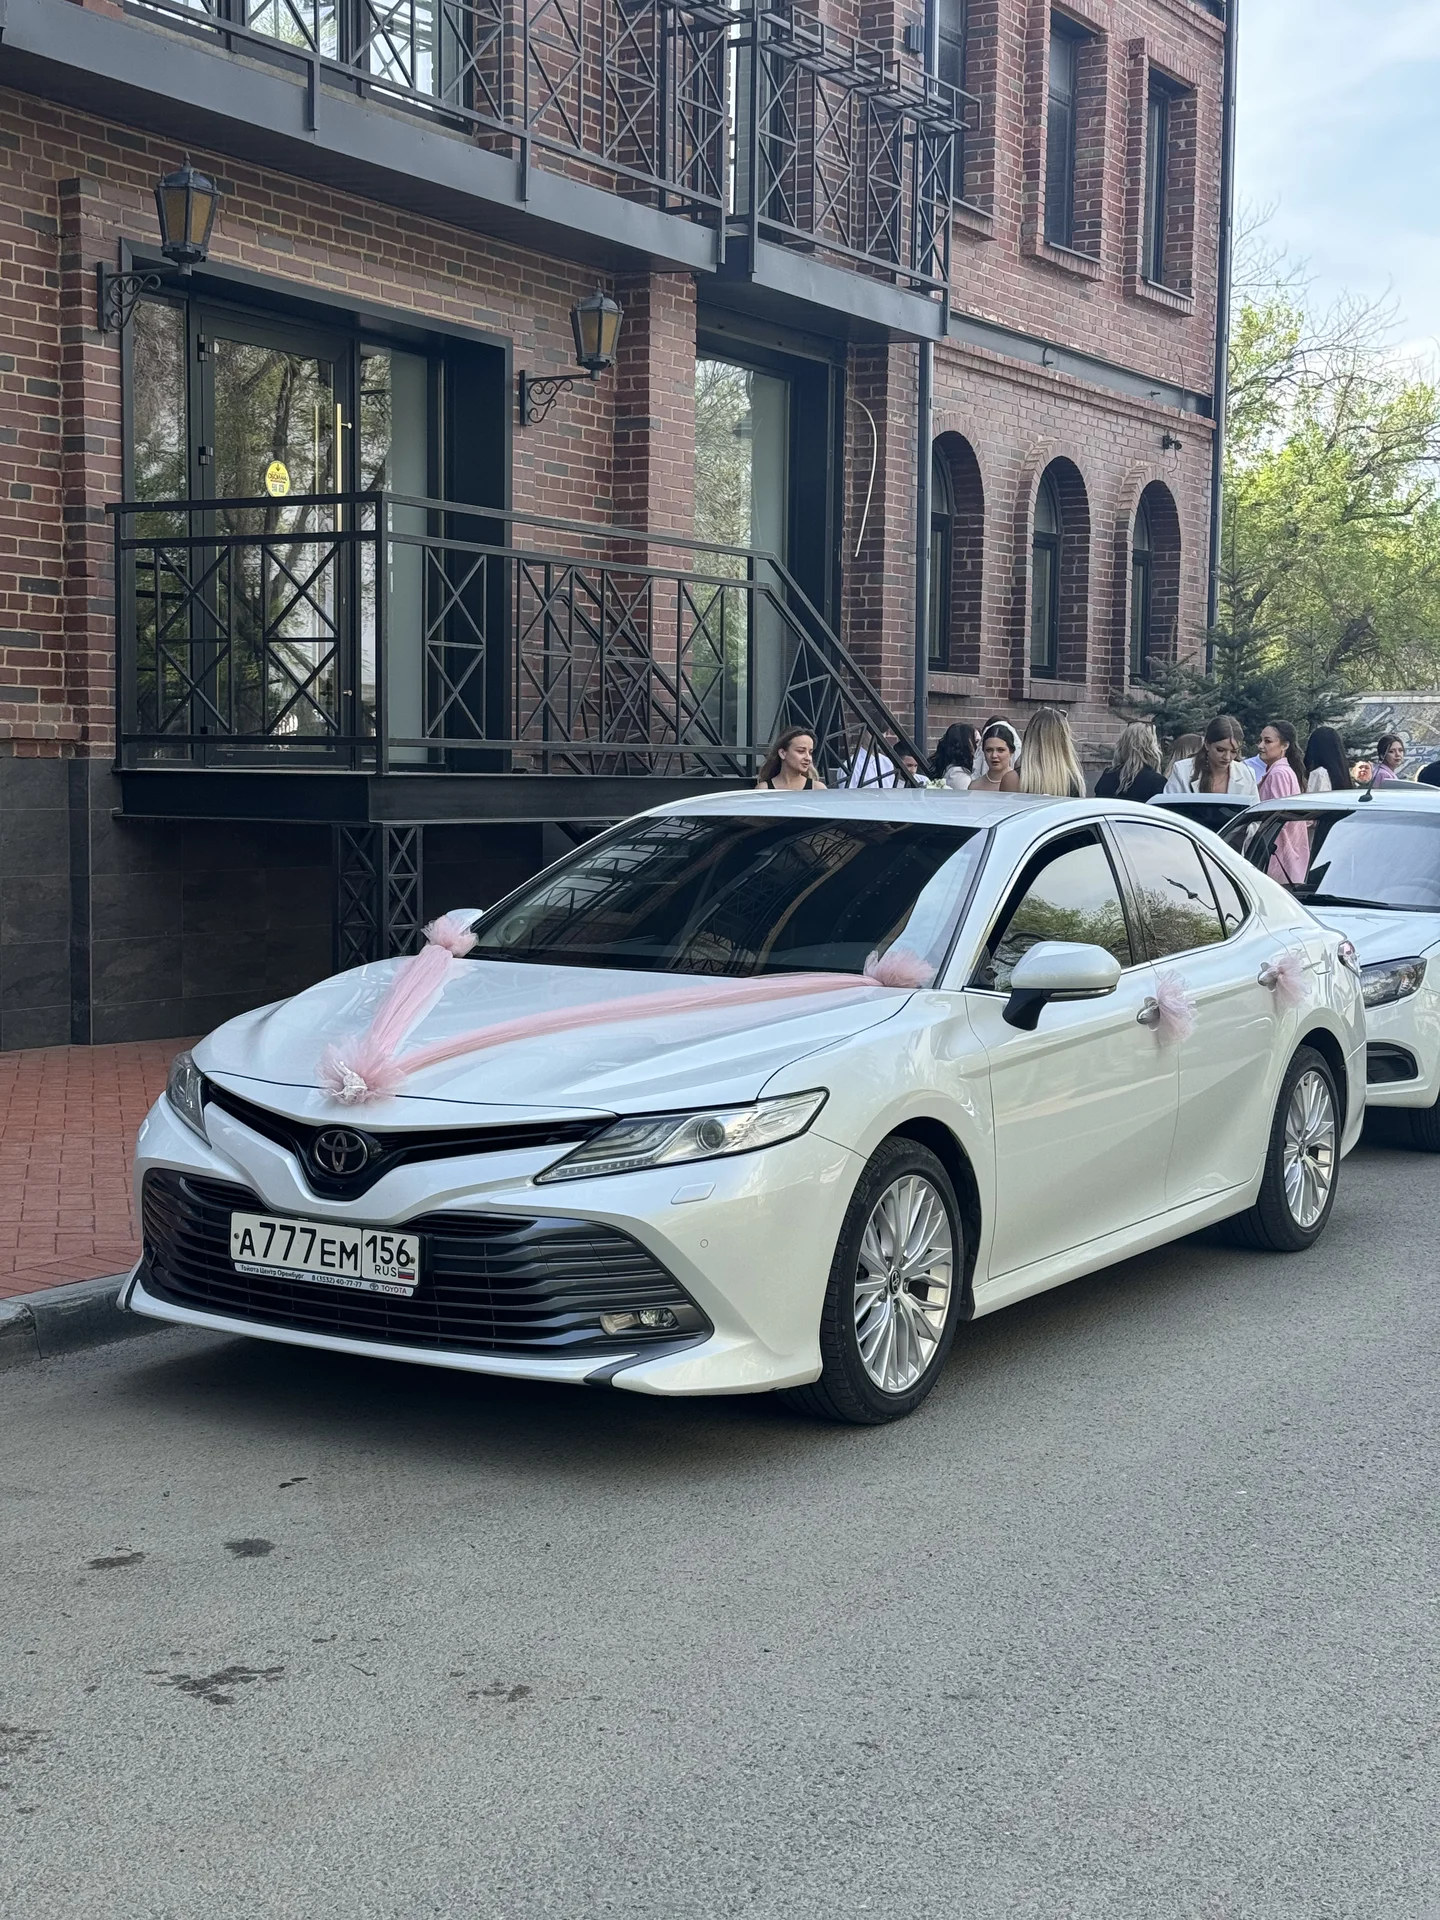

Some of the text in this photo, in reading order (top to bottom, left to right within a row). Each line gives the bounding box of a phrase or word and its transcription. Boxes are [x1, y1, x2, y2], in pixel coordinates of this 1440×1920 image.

[365, 1234, 411, 1267] 156
[240, 1264, 260, 1273] Тойота
[260, 1267, 277, 1276] Центр
[277, 1269, 304, 1279] Оренбург
[336, 1278, 362, 1287] 40-77-77
[374, 1264, 397, 1278] RUS
[381, 1285, 407, 1294] TOYOTA
